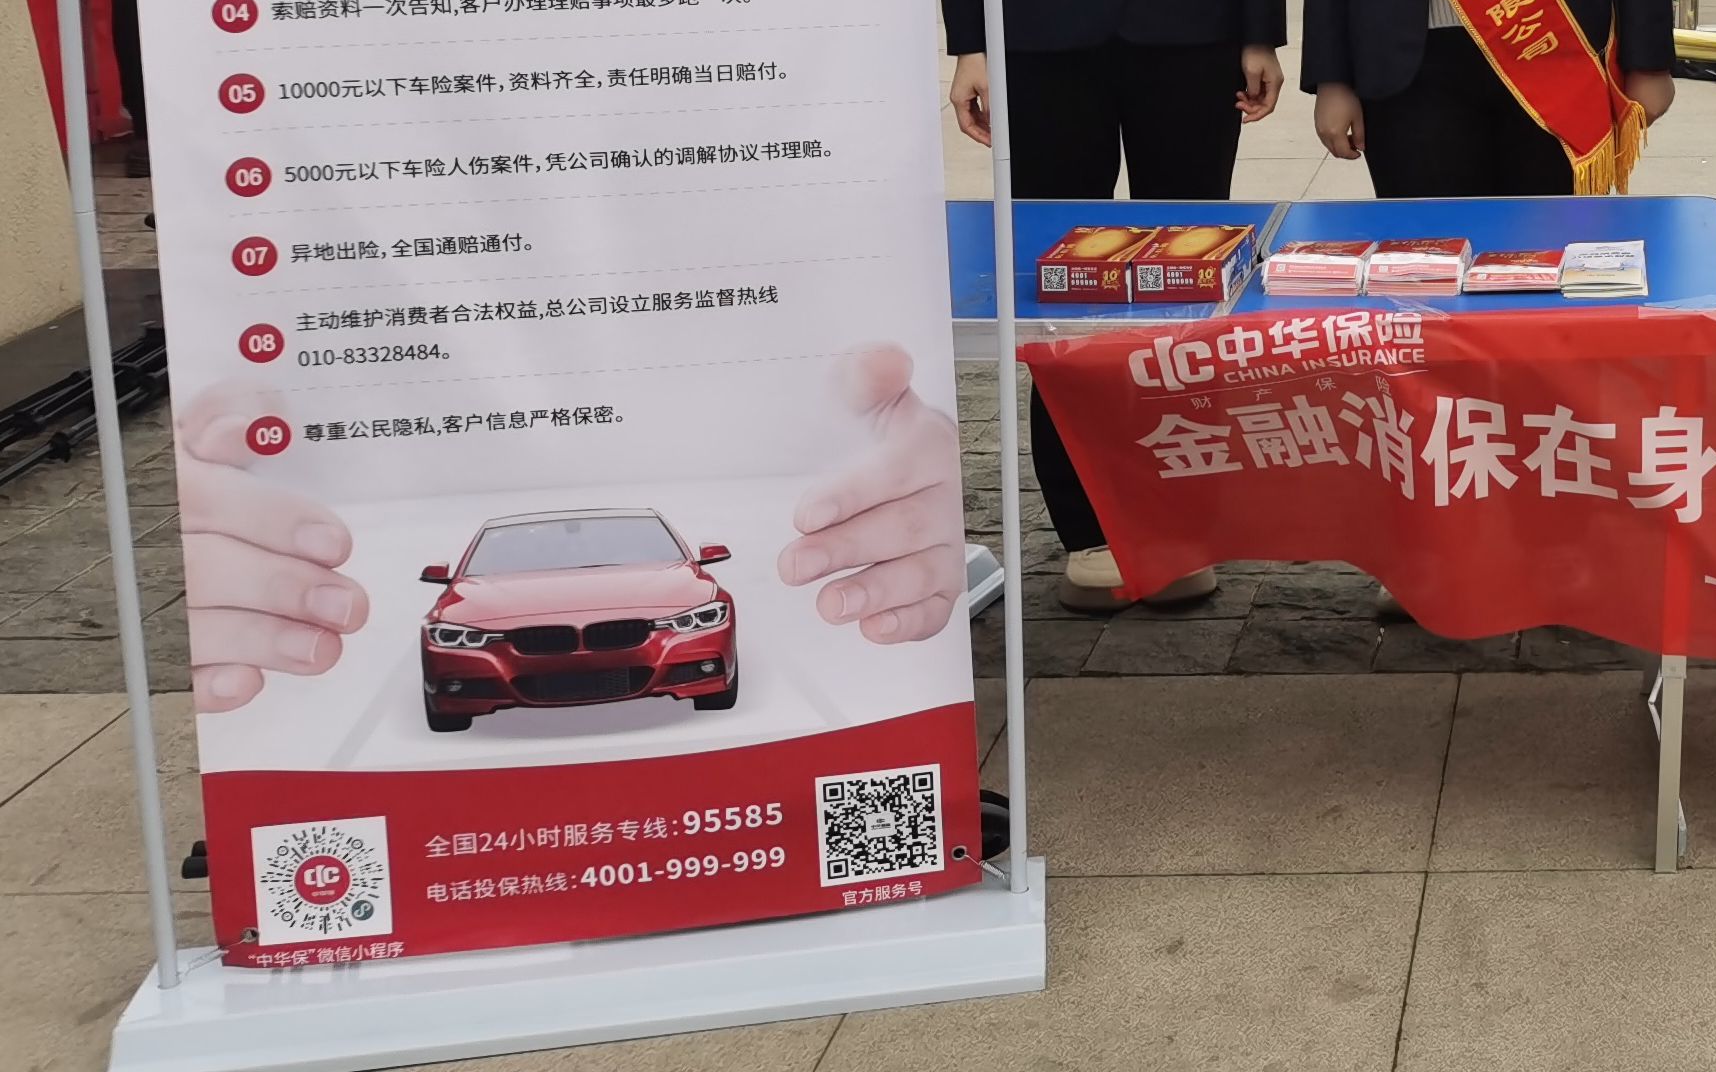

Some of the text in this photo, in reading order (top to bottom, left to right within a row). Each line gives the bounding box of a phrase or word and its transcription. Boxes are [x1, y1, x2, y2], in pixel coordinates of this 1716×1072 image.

[221, 3, 250, 23] 04
[228, 84, 257, 105] 05
[234, 167, 263, 187] 06
[240, 246, 269, 266] 07
[247, 333, 276, 354] 08
[1218, 311, 1425, 368] 中华保险
[1223, 347, 1426, 384] CHINA INSURANCE
[1190, 376, 1392, 410] 财产保险
[254, 426, 284, 447] 09
[842, 881, 924, 907] 官方服务号
